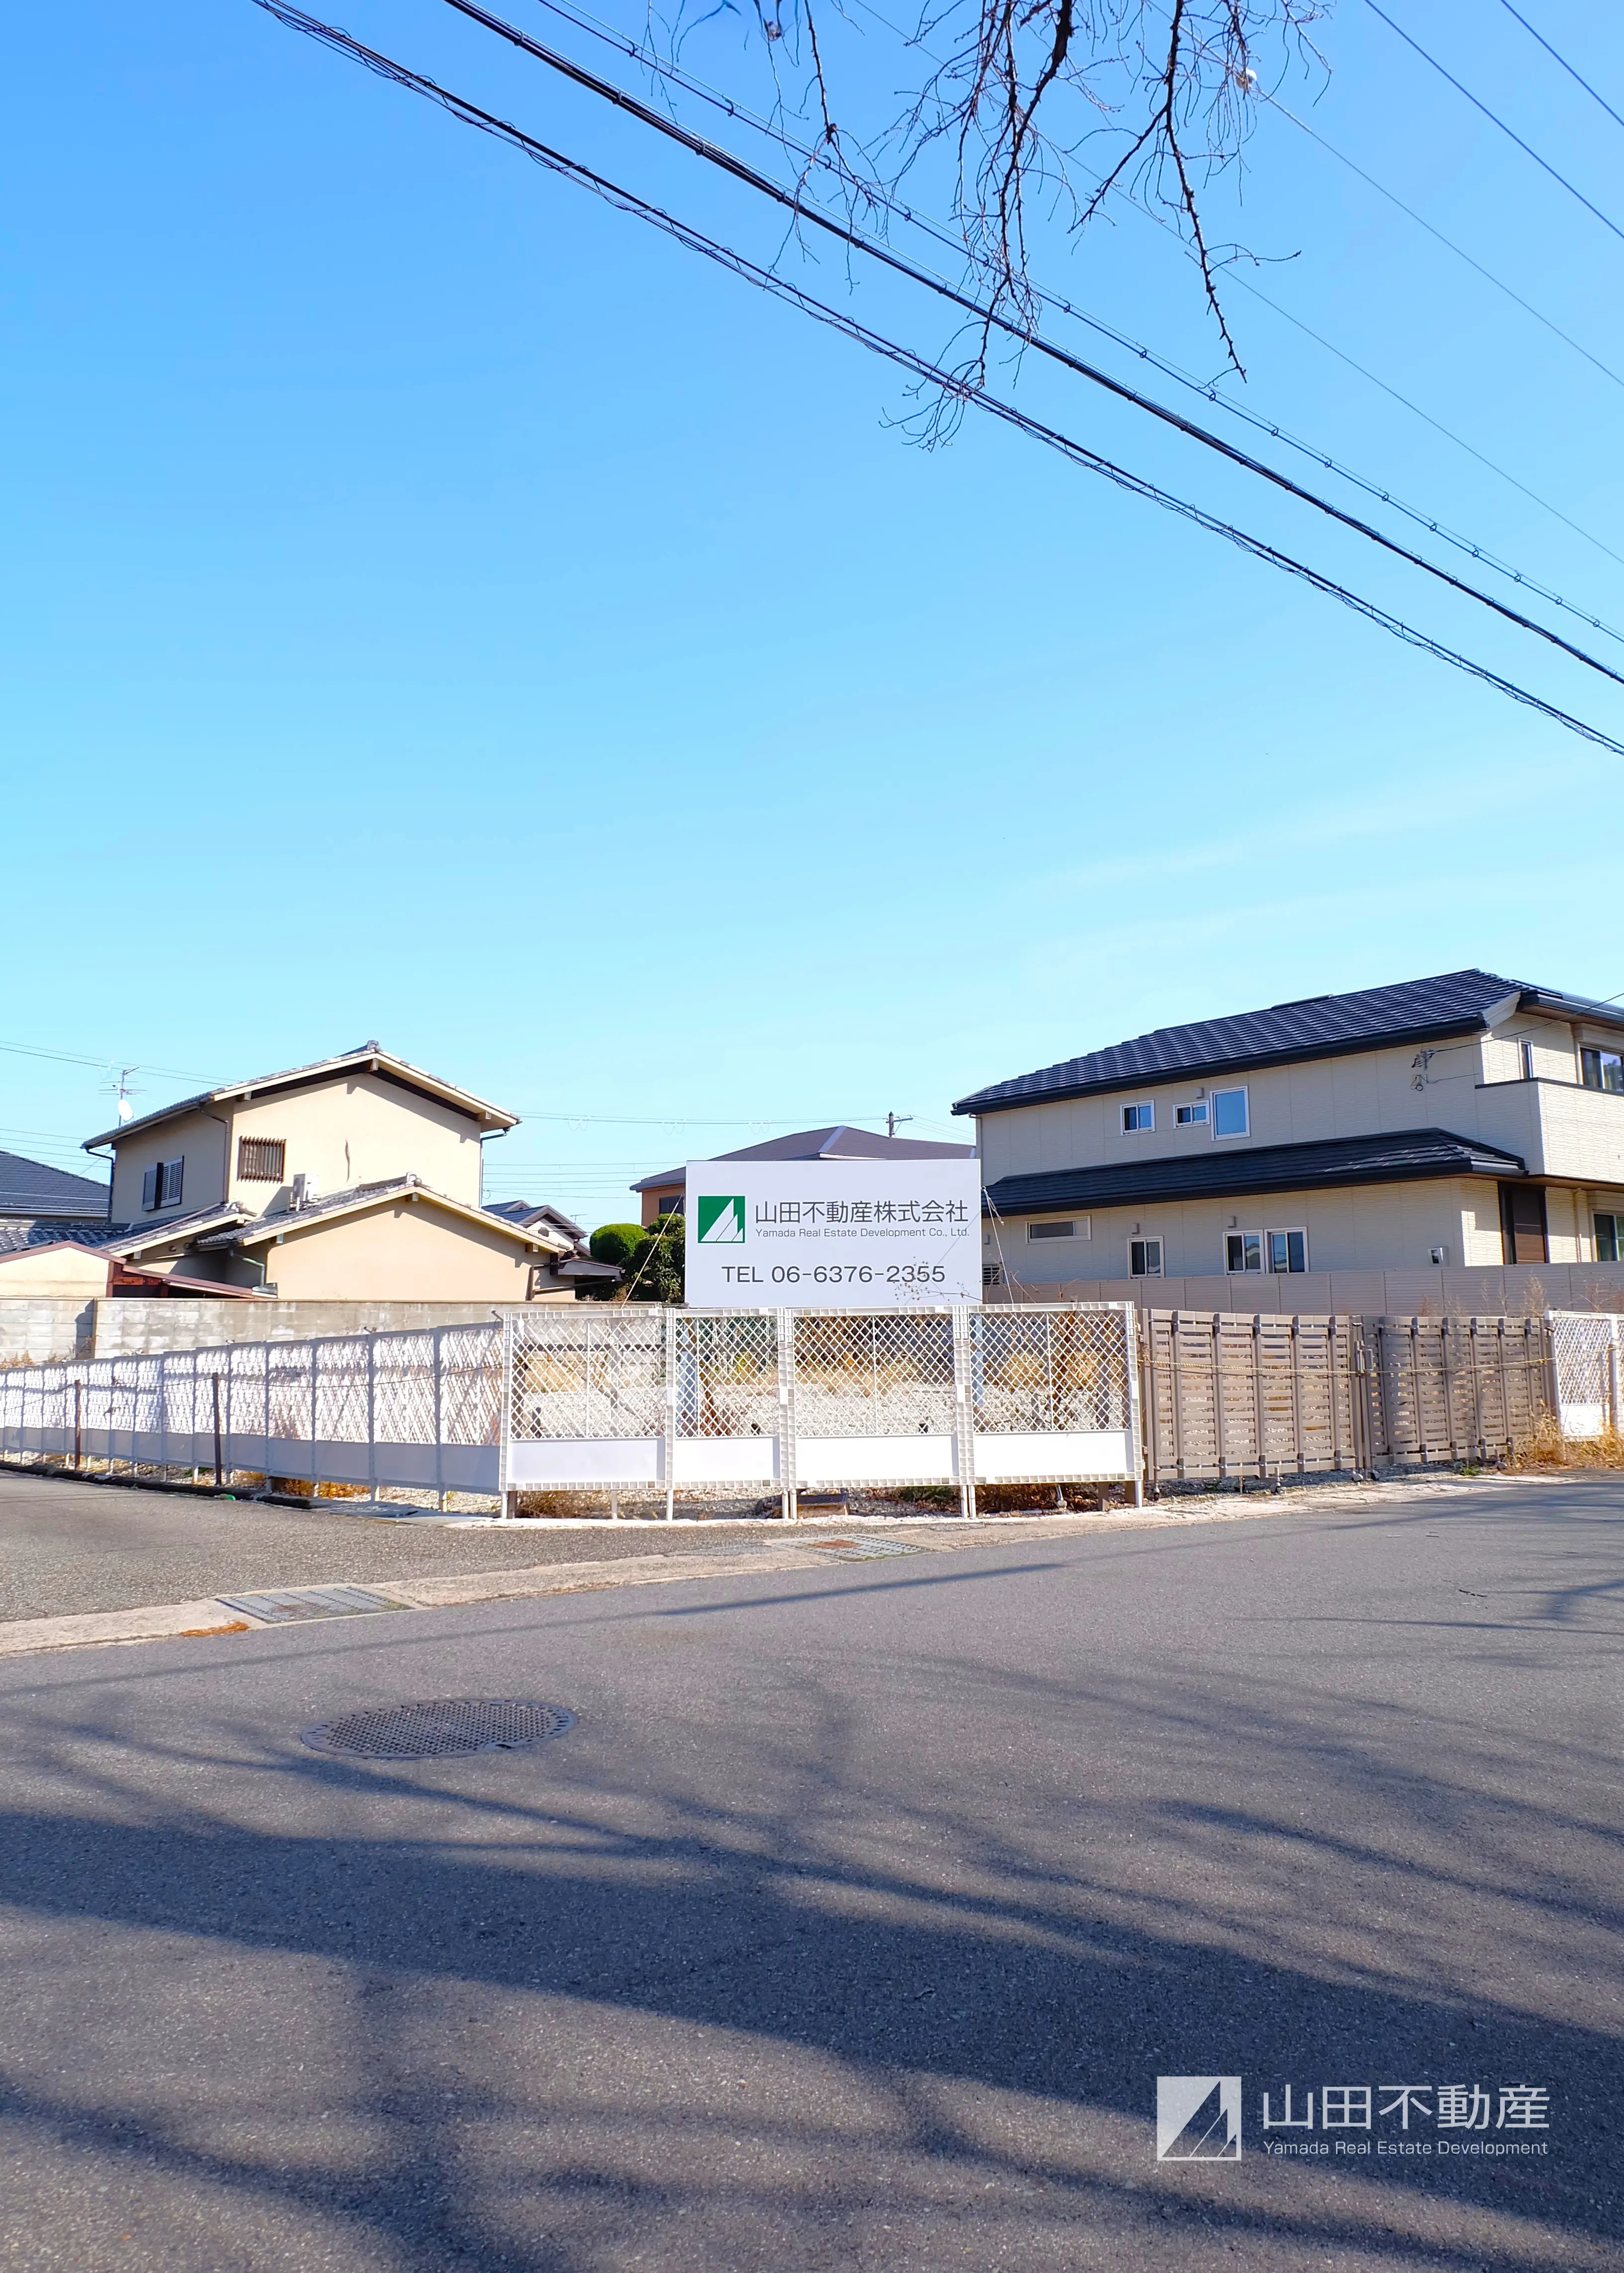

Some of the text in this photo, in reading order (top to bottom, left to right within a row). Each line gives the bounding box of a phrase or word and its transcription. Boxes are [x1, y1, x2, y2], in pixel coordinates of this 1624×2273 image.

[755, 1199, 969, 1224] 山田不動産株式会社
[755, 1227, 970, 1238] Yamada Real Estate Development Co., Ltd.
[721, 1266, 945, 1283] TEL 06-6376-2355
